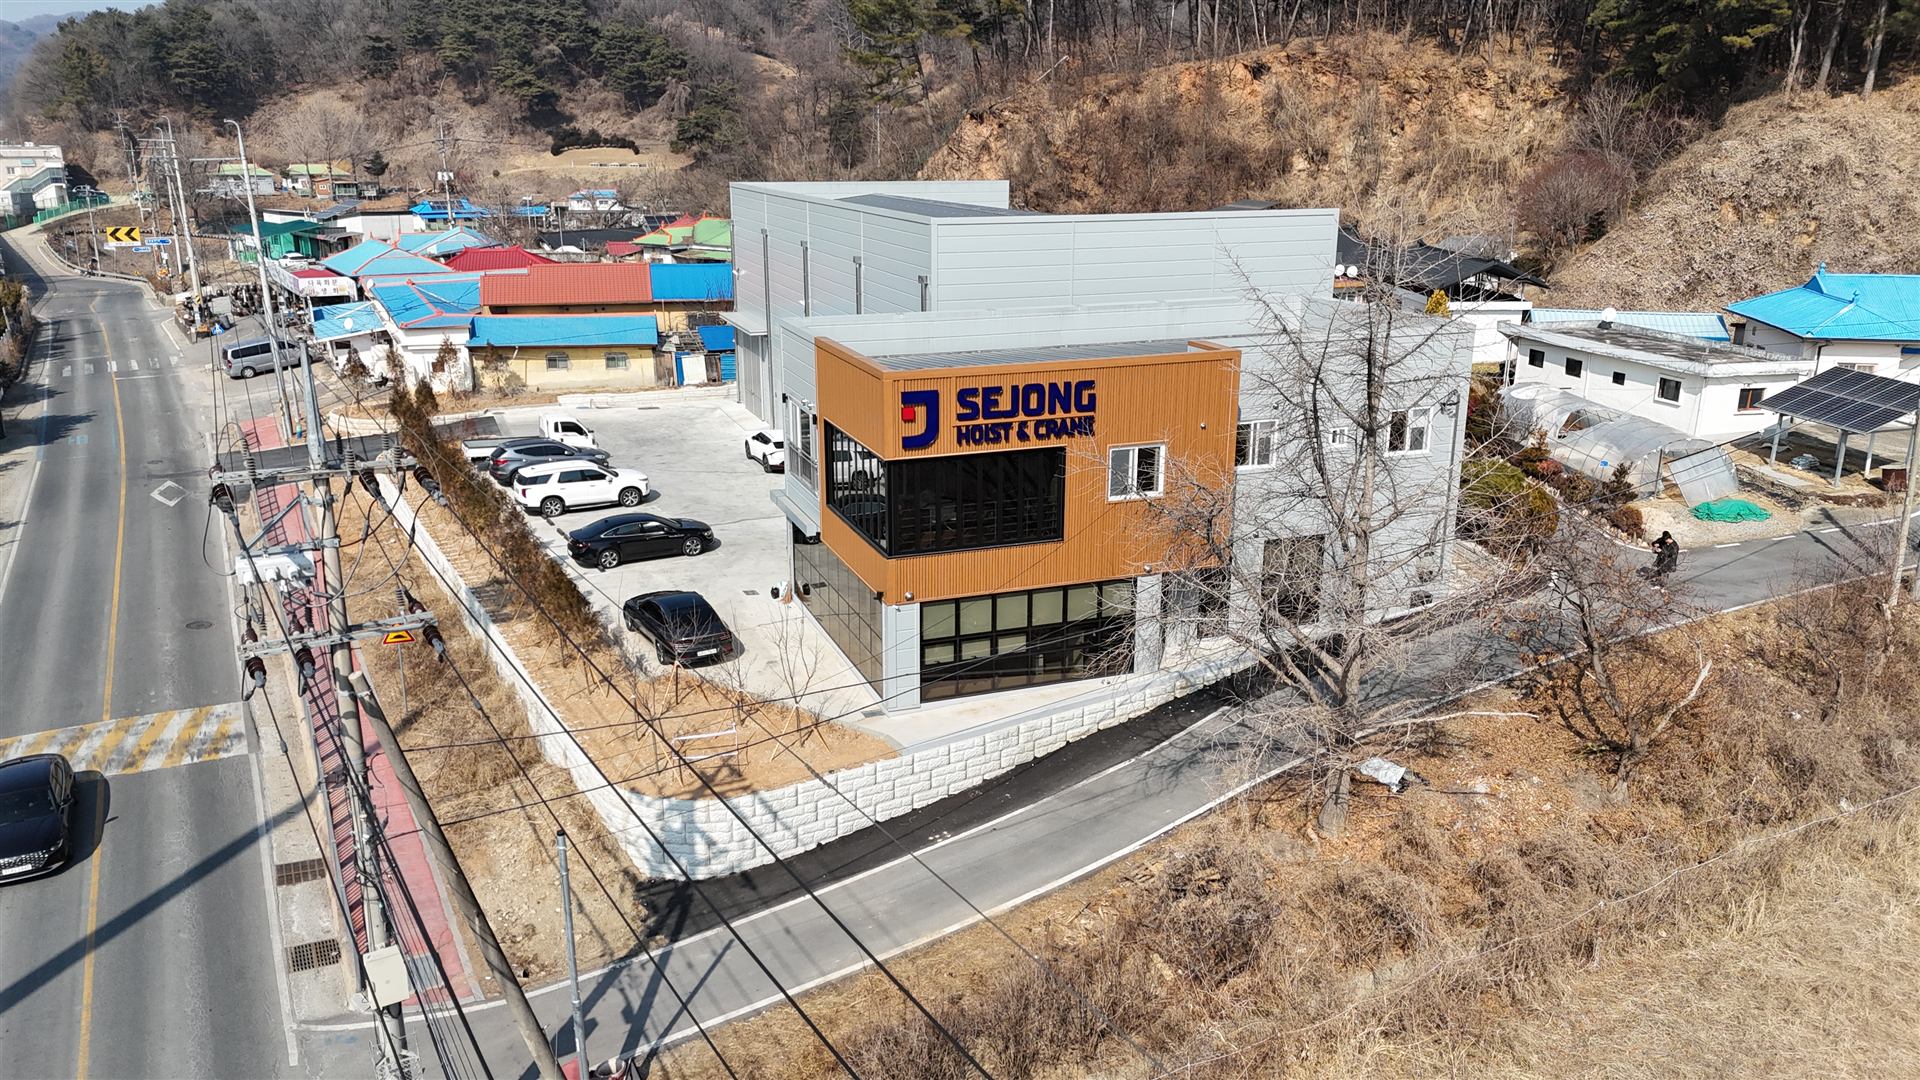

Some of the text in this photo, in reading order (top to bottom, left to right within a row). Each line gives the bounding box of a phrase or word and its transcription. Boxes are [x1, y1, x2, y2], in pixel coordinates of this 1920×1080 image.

[956, 380, 1097, 421] SEJONG
[956, 422, 1014, 446] HOIST
[1016, 421, 1031, 441] &
